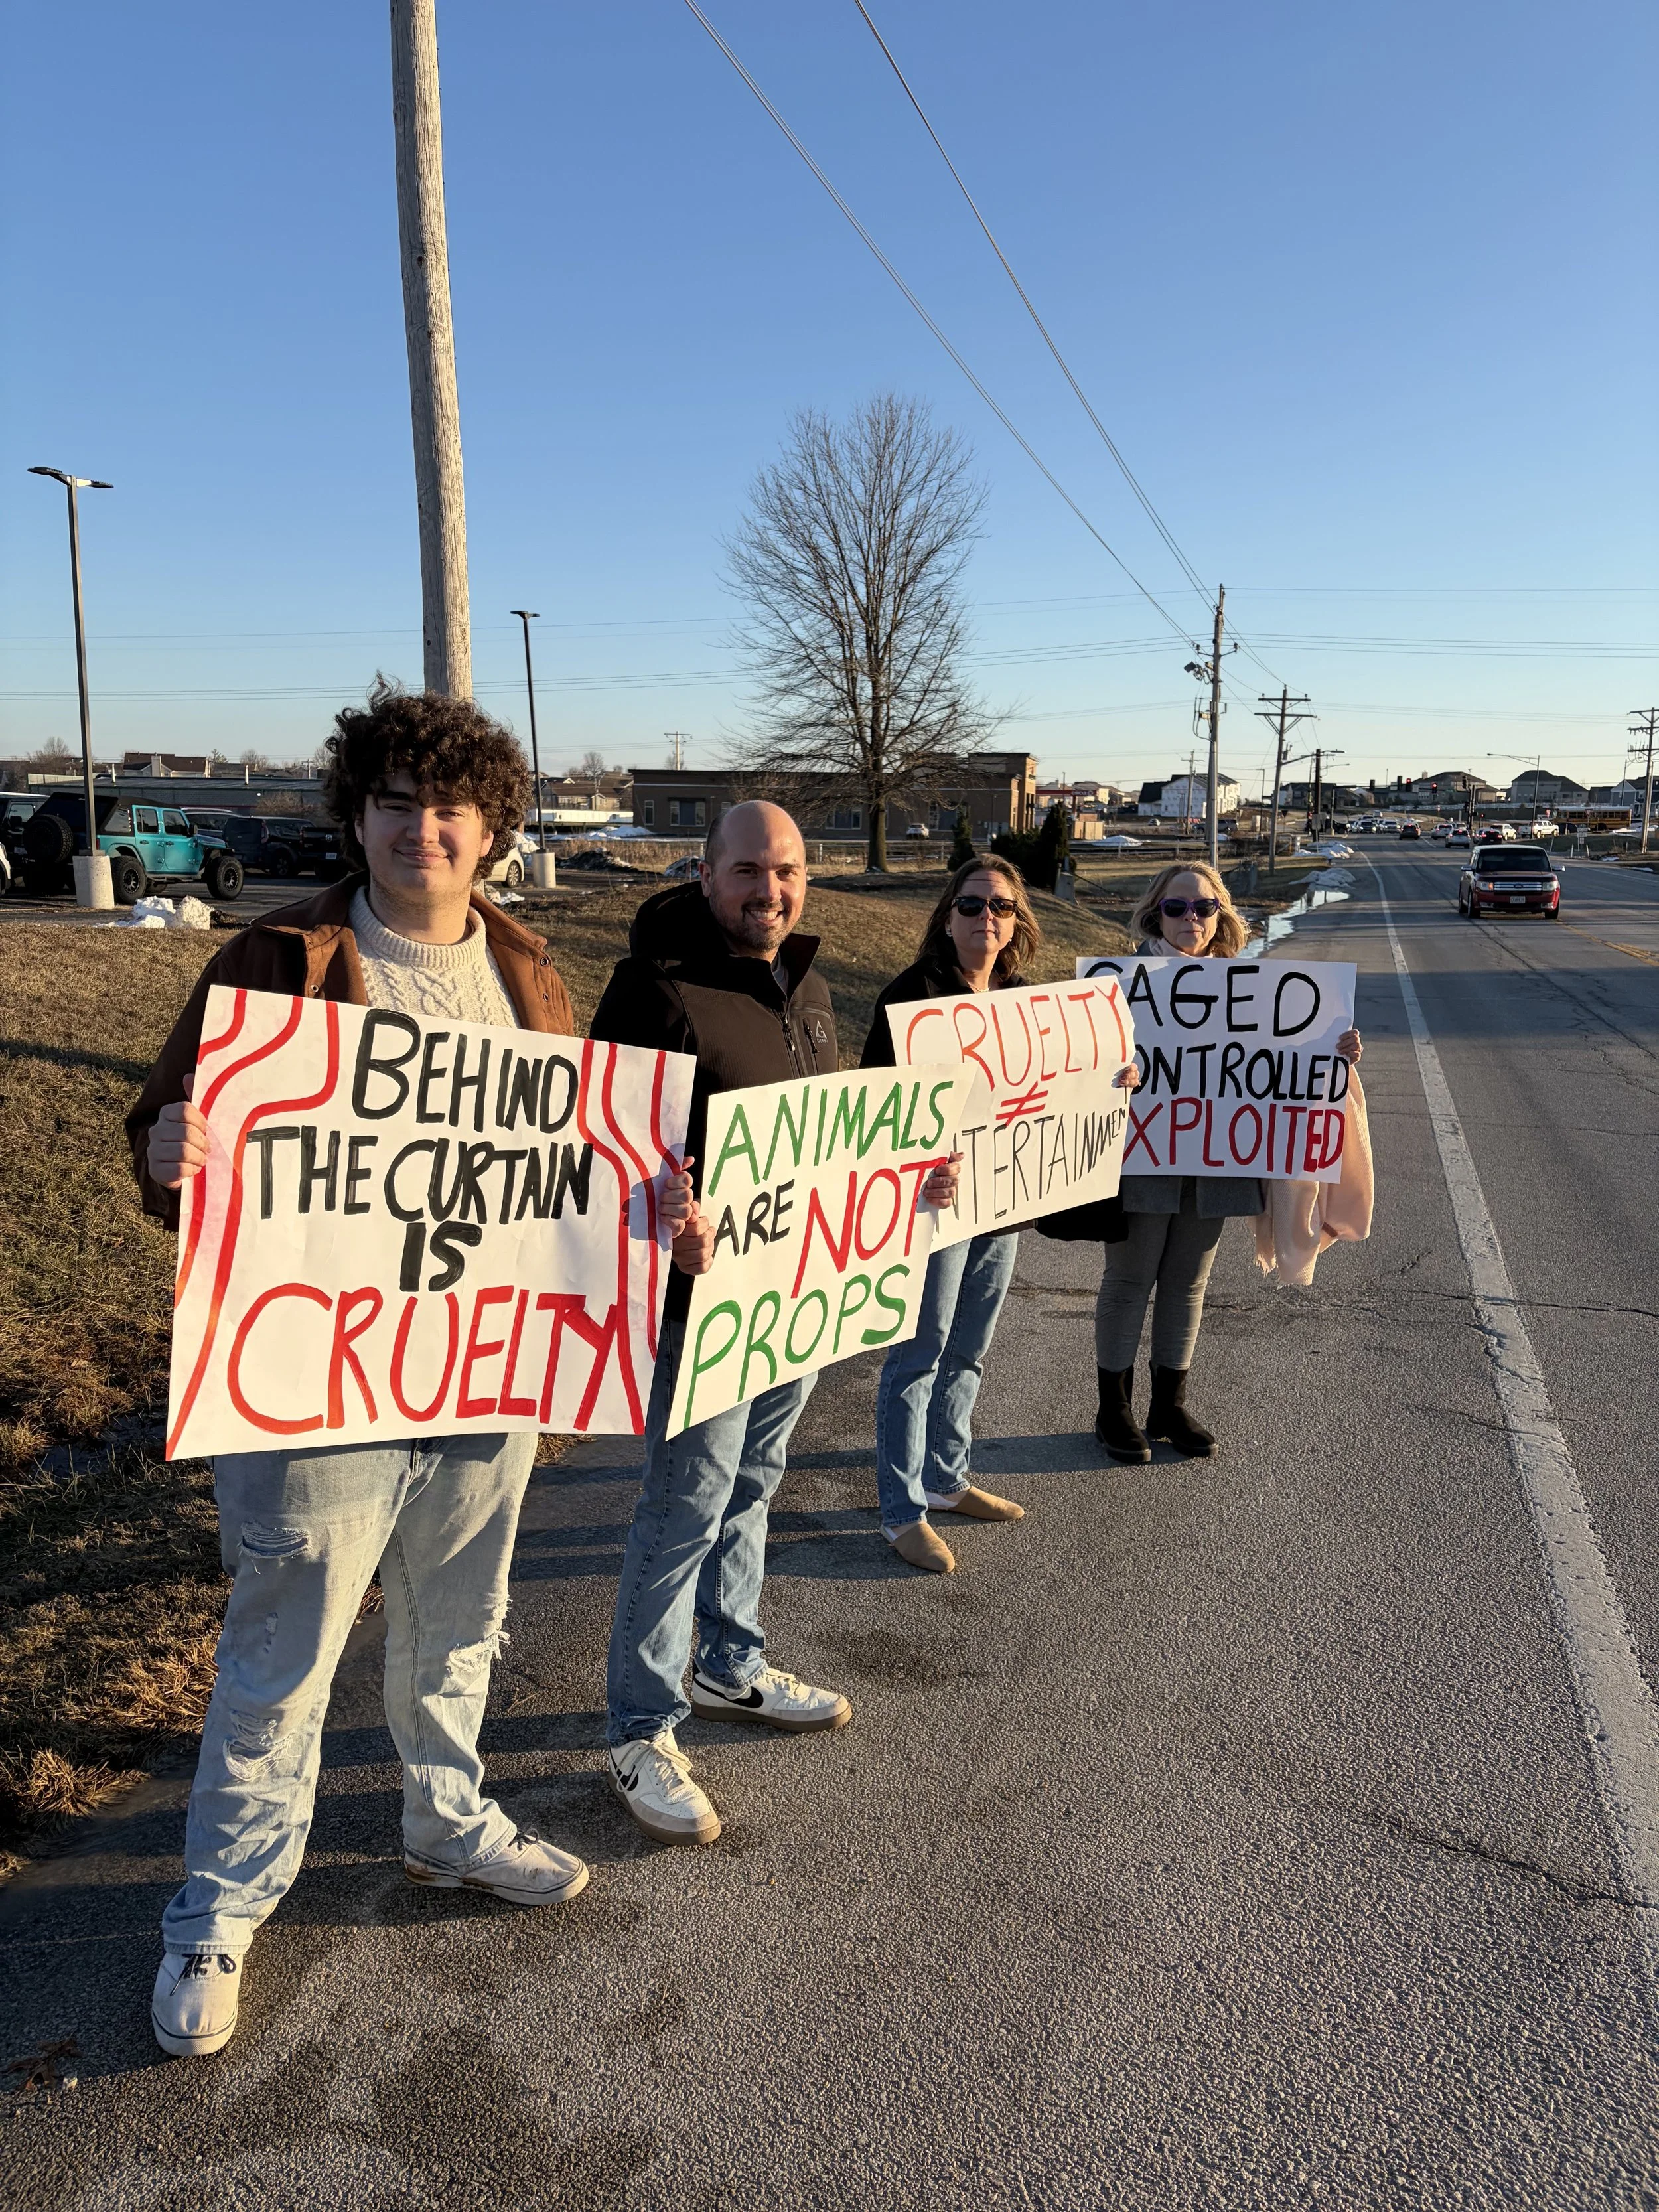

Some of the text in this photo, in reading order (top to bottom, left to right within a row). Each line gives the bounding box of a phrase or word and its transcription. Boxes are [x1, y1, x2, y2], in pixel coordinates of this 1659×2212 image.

[352, 1008, 578, 1133] BEHIND
[906, 982, 1127, 1090] CRUELTY
[1131, 1042, 1350, 1103] ONTROLLED
[246, 1126, 594, 1224] THE CURTAIN
[709, 1081, 954, 1197] ANIMALS
[1123, 1097, 1346, 1175] XPLOITED
[400, 1221, 482, 1292] IS
[713, 1157, 948, 1299] ARE NOT
[227, 1282, 618, 1435] CRUELTY
[684, 1264, 910, 1431] PROPS
